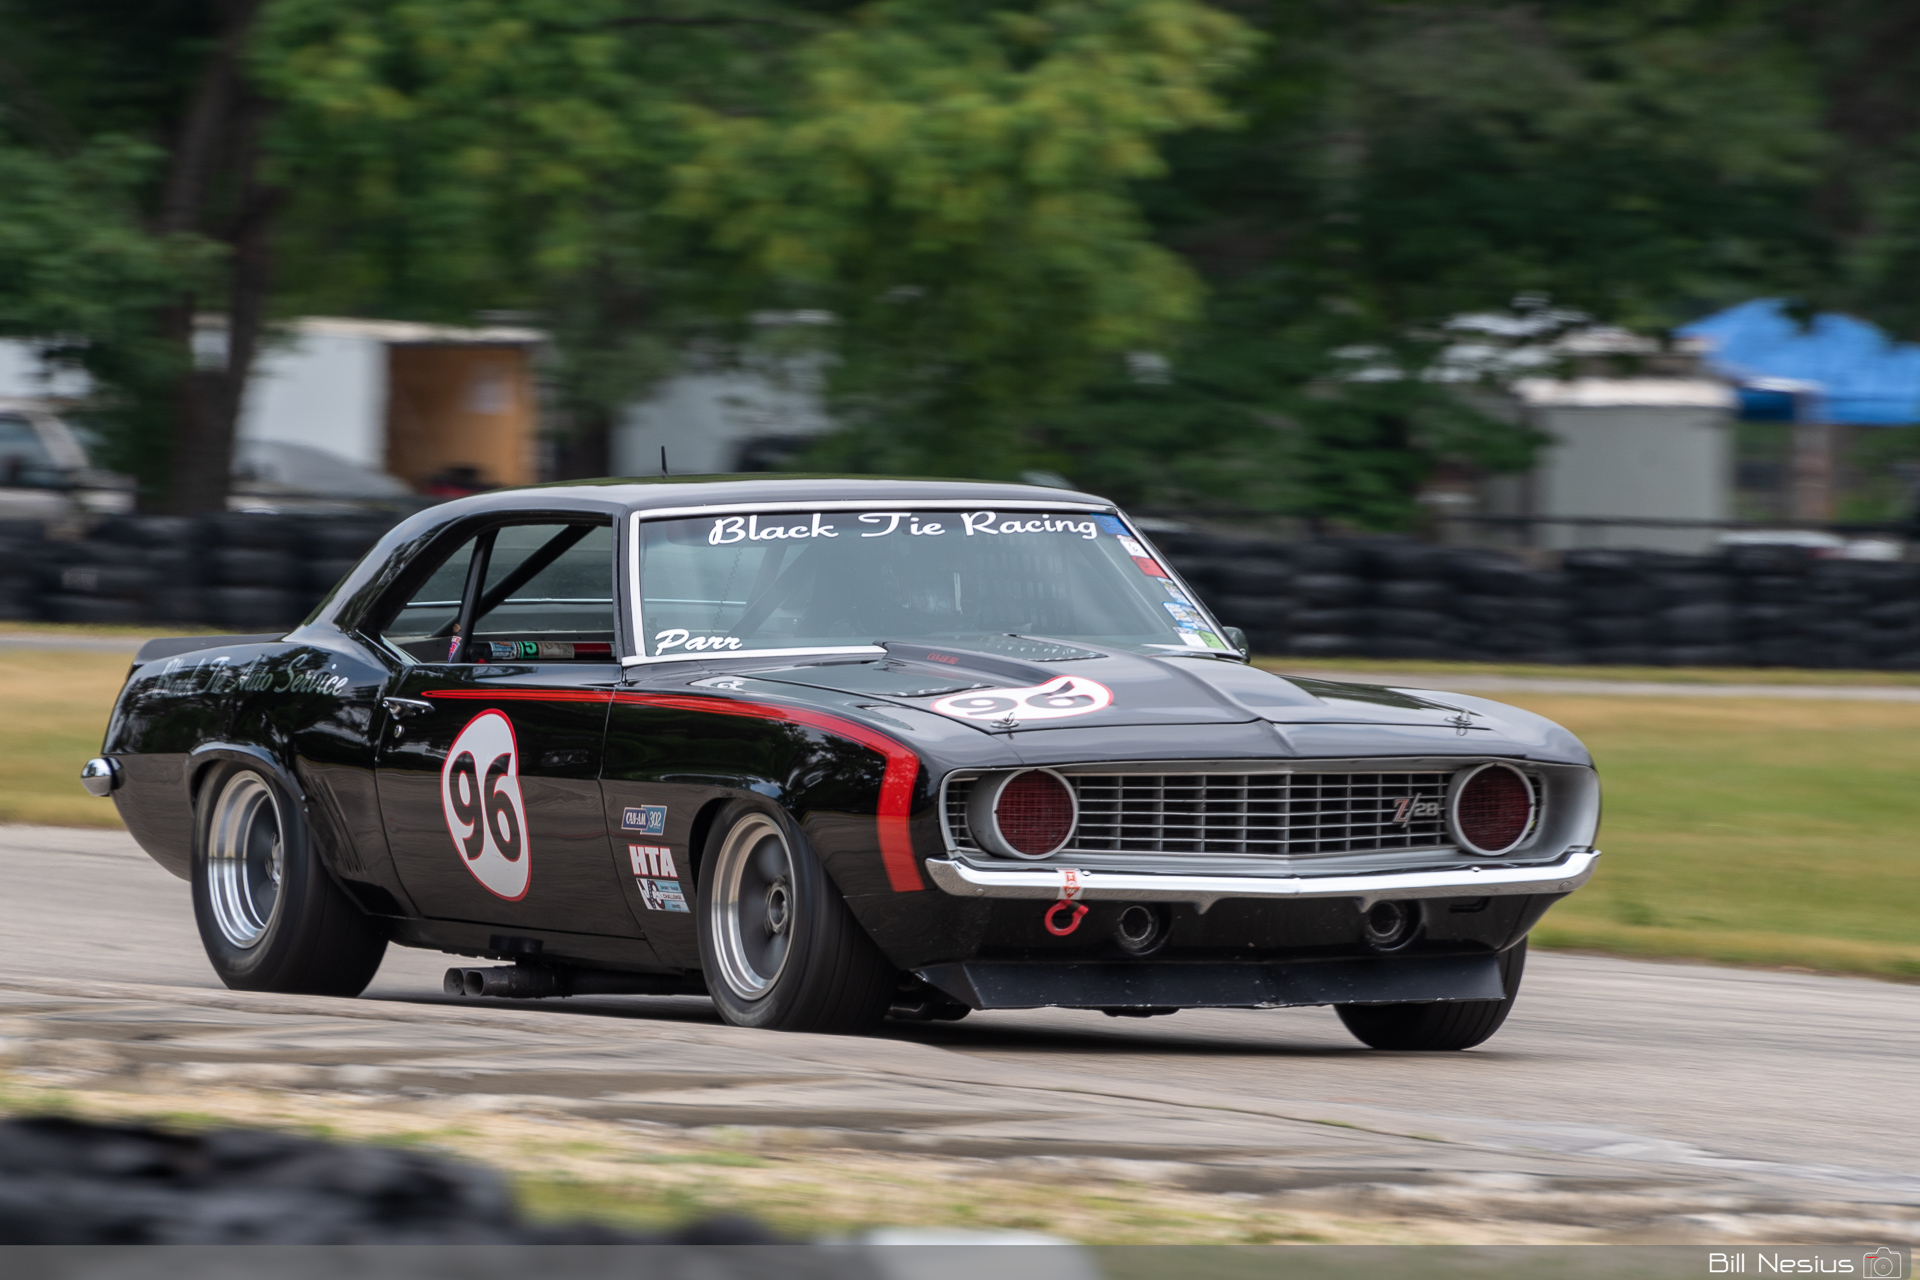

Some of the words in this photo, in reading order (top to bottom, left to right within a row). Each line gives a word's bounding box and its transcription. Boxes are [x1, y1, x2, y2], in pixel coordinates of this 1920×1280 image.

[708, 513, 839, 545] Black
[858, 511, 946, 539] Tie
[960, 511, 1099, 540] Racing
[655, 628, 742, 656] Parr
[224, 653, 275, 693] Auto
[274, 652, 349, 696] Service
[948, 679, 1097, 716] 96
[448, 750, 522, 863] 96
[625, 811, 647, 826] CAN-AM
[649, 810, 662, 828] 302
[1393, 792, 1439, 829] Z/28
[628, 844, 679, 879] HTA
